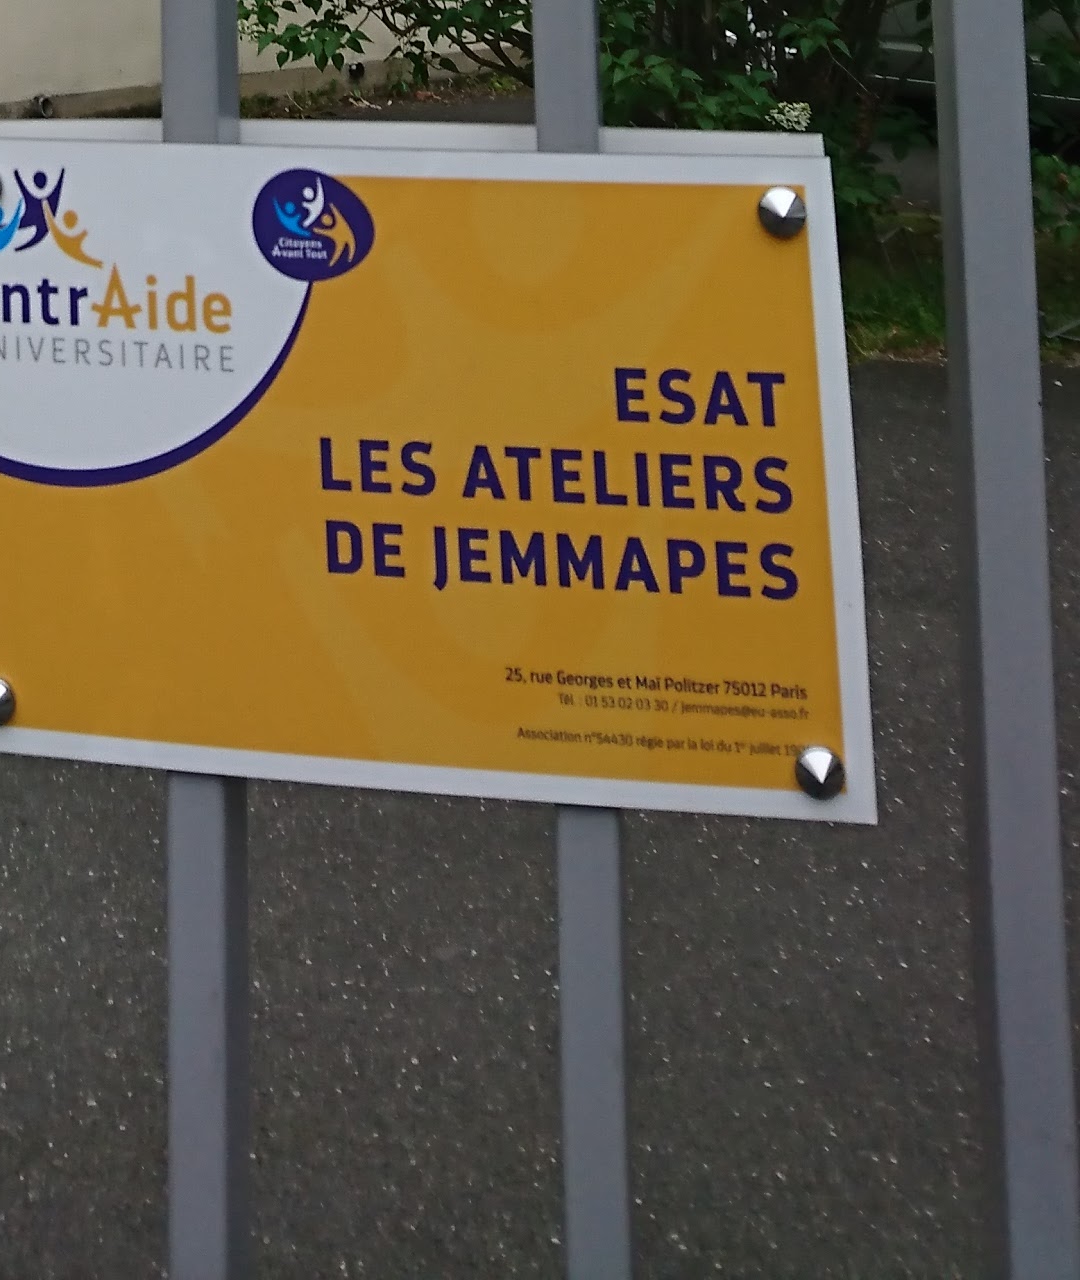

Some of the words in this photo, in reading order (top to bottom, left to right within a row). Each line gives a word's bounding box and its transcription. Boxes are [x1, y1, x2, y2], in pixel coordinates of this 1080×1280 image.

[272, 244, 304, 258] Avant
[305, 249, 328, 259] Tout
[614, 367, 786, 427] ESAT
[320, 437, 436, 496] LES
[462, 444, 793, 514] ATELIERS
[325, 520, 406, 578] DE
[433, 526, 799, 601] JEMMAPES
[505, 667, 526, 684] 25,
[530, 671, 553, 684] rue
[556, 670, 613, 689] Georges
[617, 677, 632, 689] et
[664, 677, 720, 694] Politzer
[723, 680, 767, 697] 75012
[770, 683, 808, 700] Paris
